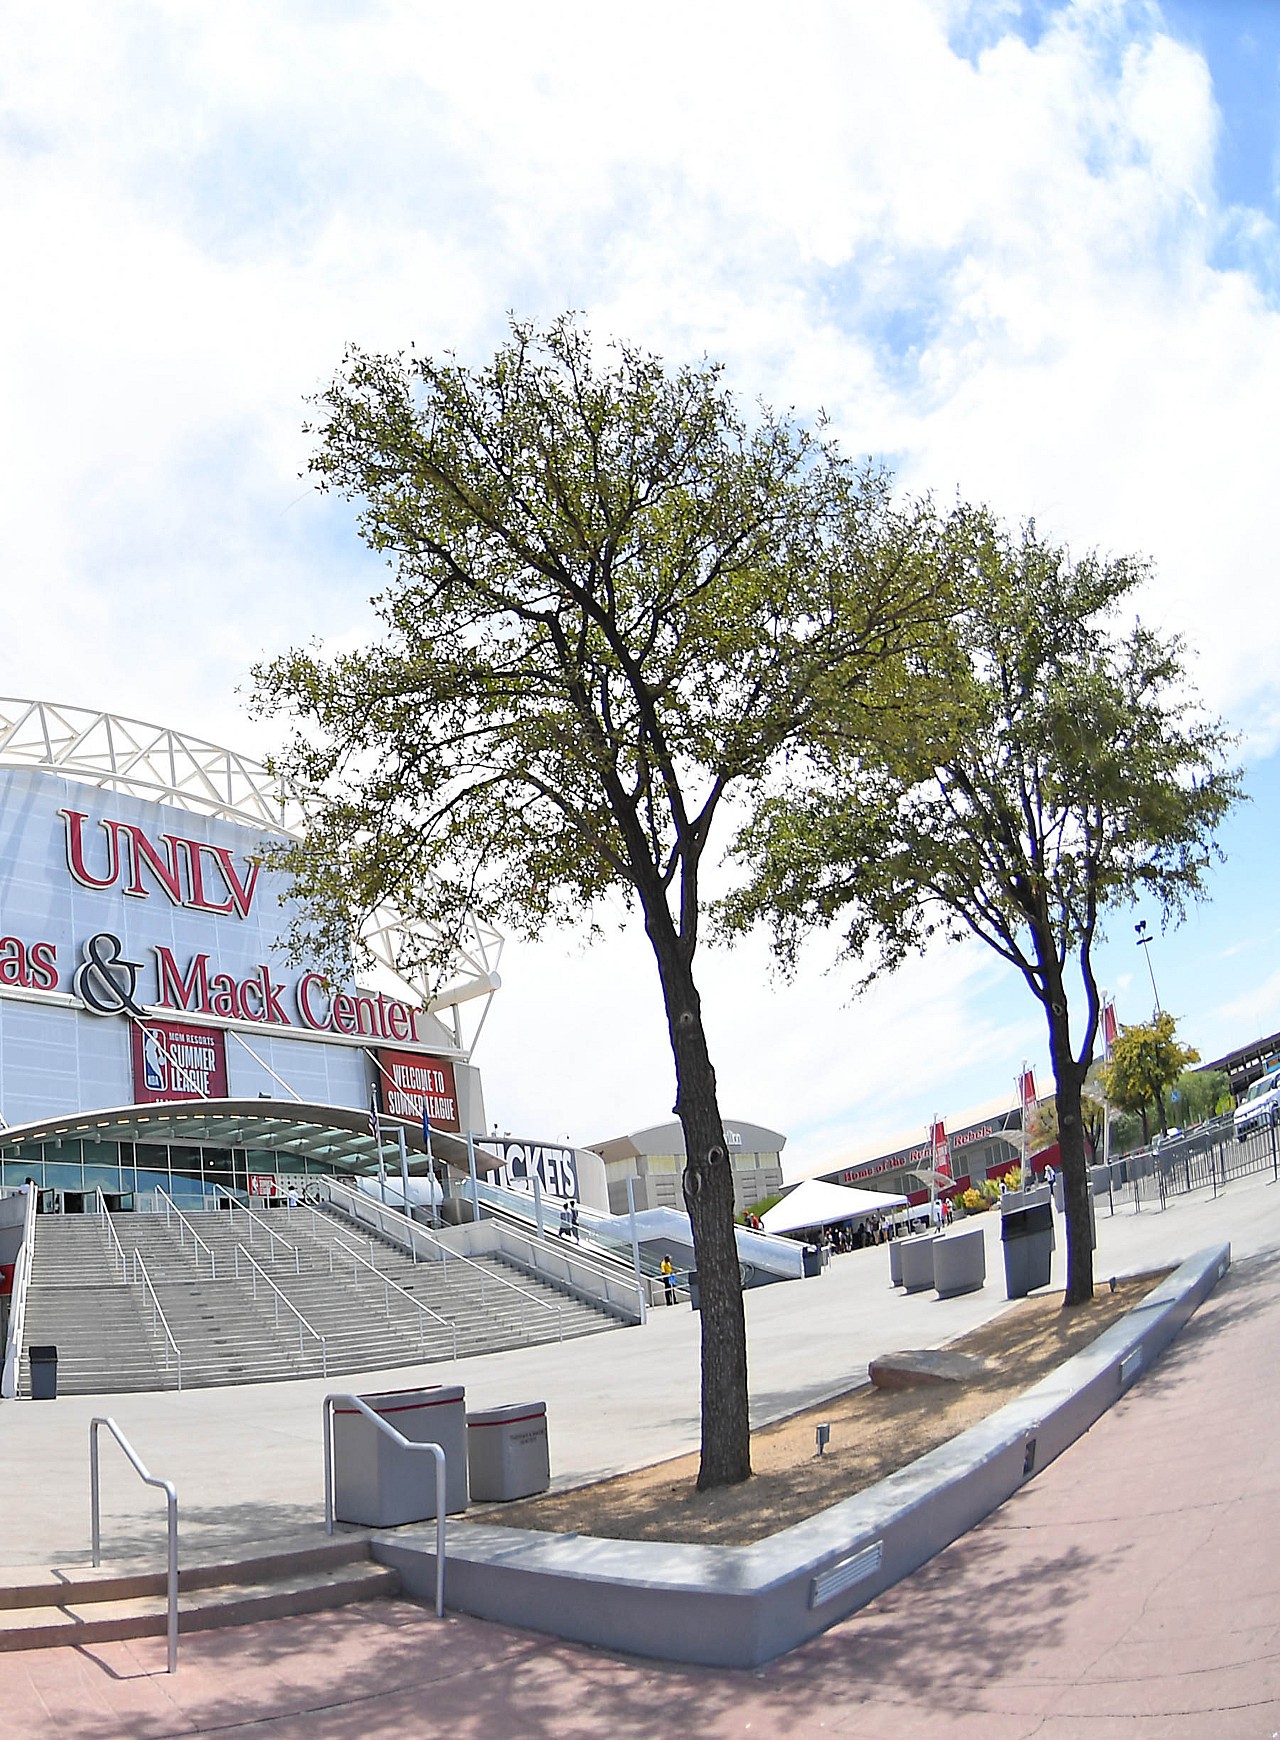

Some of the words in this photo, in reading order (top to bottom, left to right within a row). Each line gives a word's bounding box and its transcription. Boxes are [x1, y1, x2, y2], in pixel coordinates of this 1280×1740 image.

[57, 808, 265, 920] UNLV
[73, 932, 153, 1020] &
[151, 945, 292, 1025] Mack
[296, 972, 423, 1042] Center
[186, 1034, 215, 1046] RESORTS
[169, 1043, 216, 1072] SUMMER
[170, 1067, 211, 1095] LEAGUE
[392, 1063, 433, 1092] WELCOME
[432, 1070, 445, 1094] TO
[425, 1095, 455, 1121] LEAGUE
[844, 1168, 874, 1183] Home
[875, 1161, 888, 1174] of
[888, 1155, 906, 1169] the
[953, 1125, 993, 1148] Rebels
